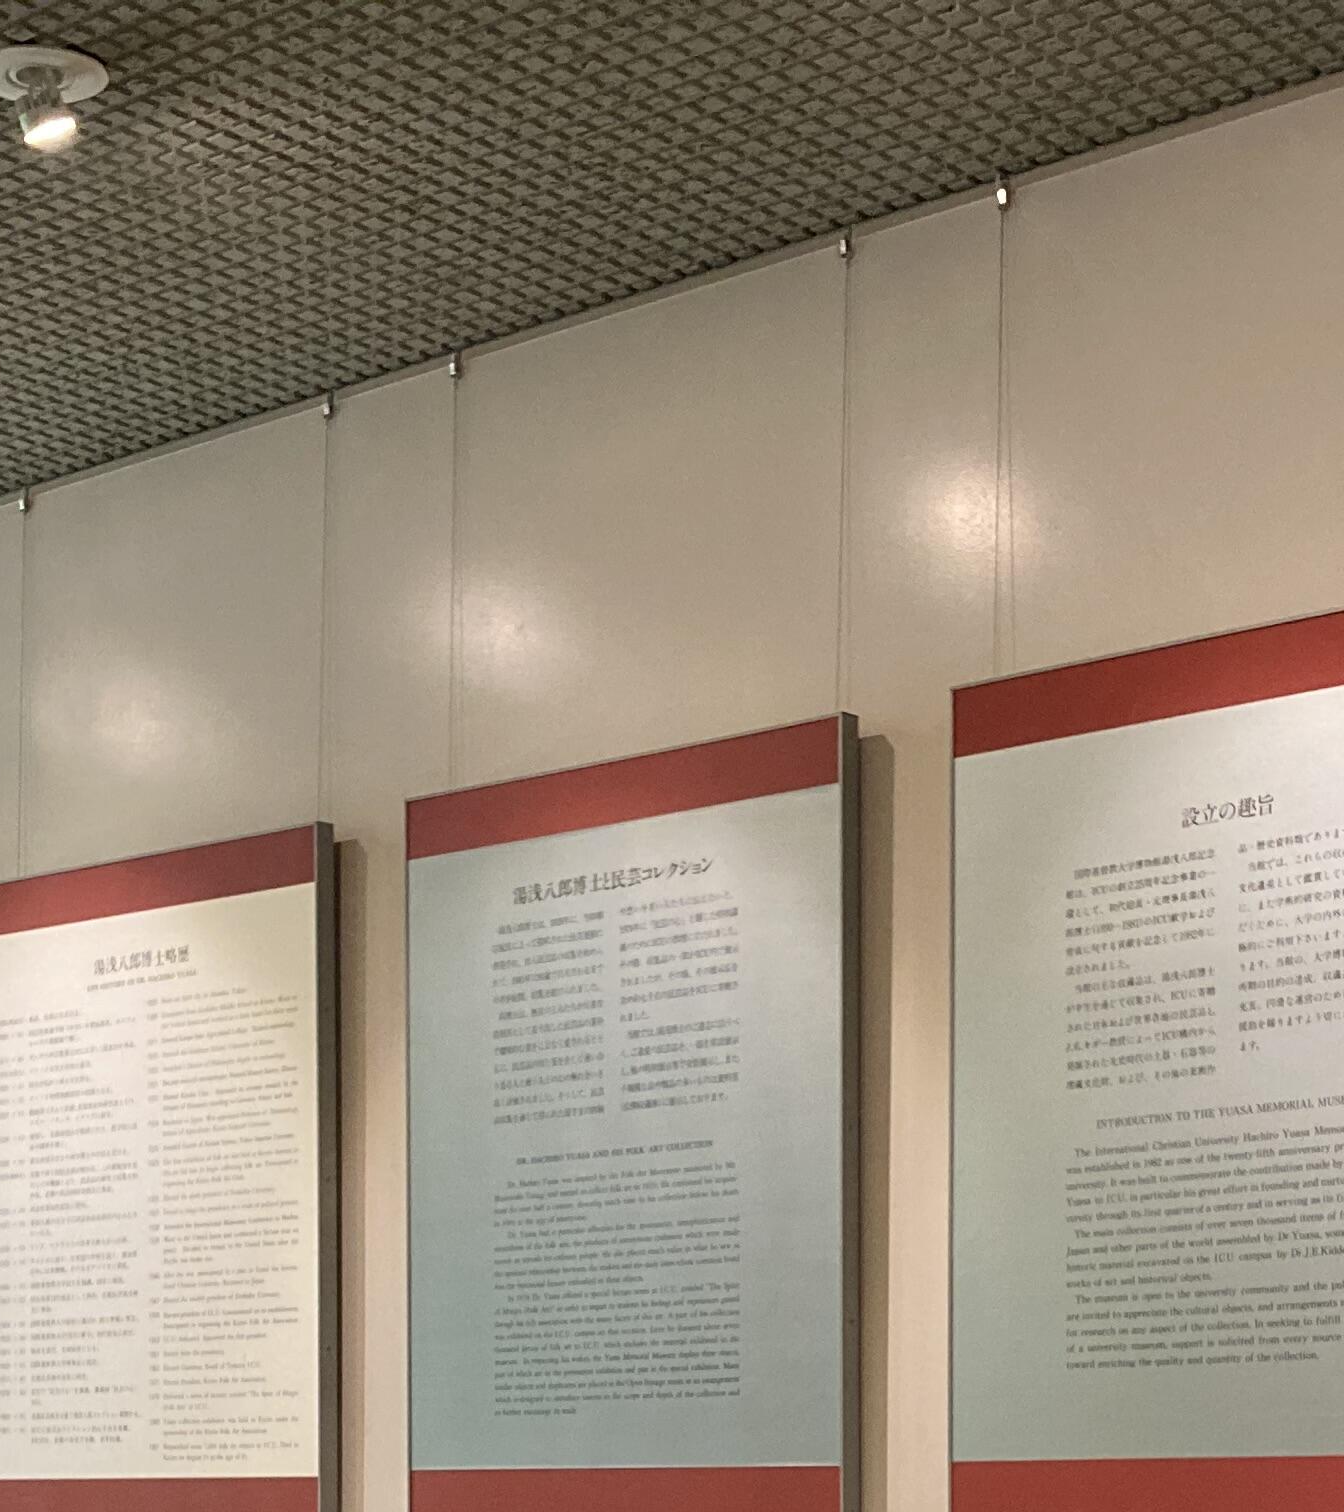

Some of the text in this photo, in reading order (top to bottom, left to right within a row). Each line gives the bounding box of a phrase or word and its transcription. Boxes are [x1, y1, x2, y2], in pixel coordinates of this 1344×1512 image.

[1181, 794, 1275, 828] 設立の趣旨
[513, 858, 713, 905] 湯浅八郎博士と民芸コレクション
[94, 944, 190, 976] 湯浅八郎博士略歴
[1096, 1111, 1173, 1130] INTRODUCTION
[1176, 1111, 1191, 1121] TO
[1194, 1108, 1216, 1120] THE
[1218, 1104, 1253, 1118] YUASA
[1256, 1099, 1315, 1114] MEMORIAL
[1150, 1138, 1191, 1150] Christian
[1193, 1133, 1240, 1149] University
[1242, 1130, 1279, 1143] Hachiro
[1281, 1127, 1309, 1139] Yuasa
[1237, 1251, 1271, 1263] campus
[1293, 1282, 1309, 1292] and
[1313, 1281, 1327, 1291] the
[1190, 1321, 1204, 1331] the
[1138, 1356, 1151, 1366] the
[1256, 1352, 1270, 1362] the
